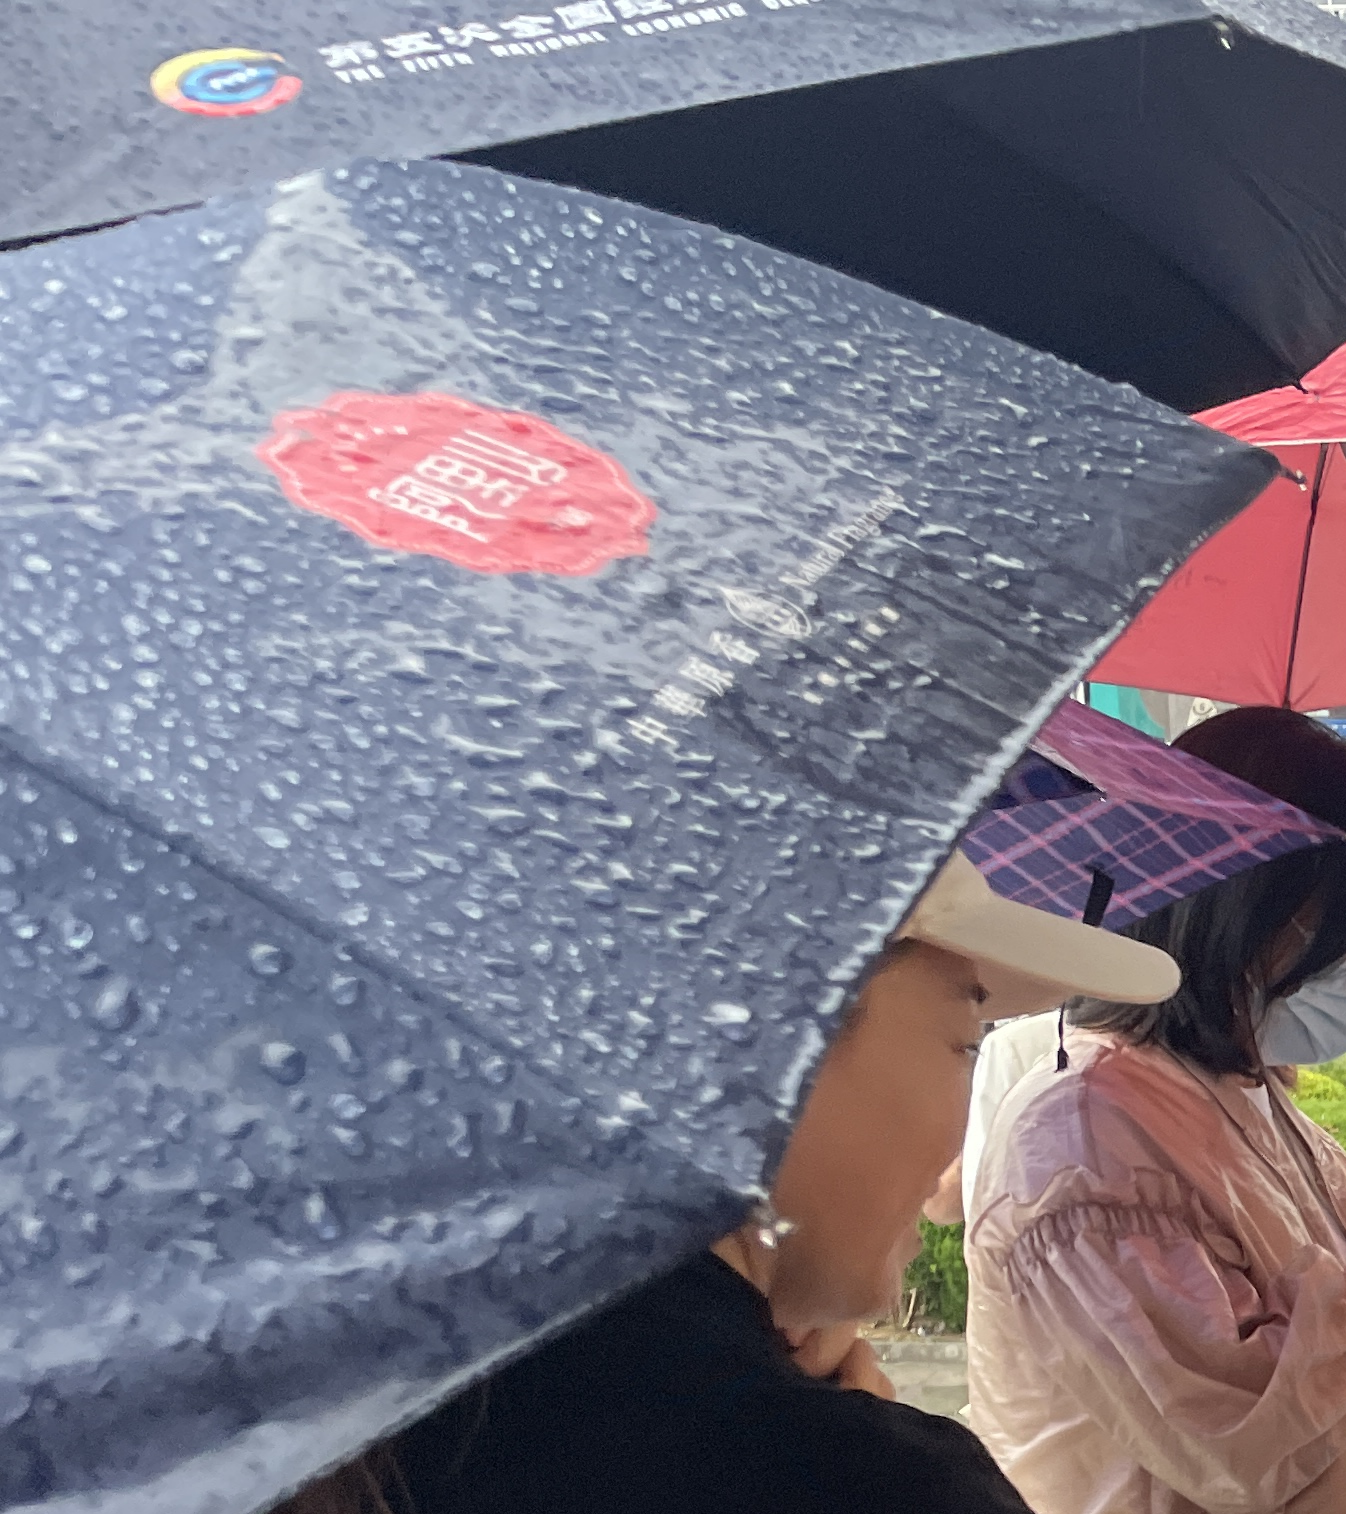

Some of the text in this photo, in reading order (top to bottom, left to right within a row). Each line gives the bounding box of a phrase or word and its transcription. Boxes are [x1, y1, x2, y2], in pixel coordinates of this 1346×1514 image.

[318, 0, 712, 68] 第五次全国经
